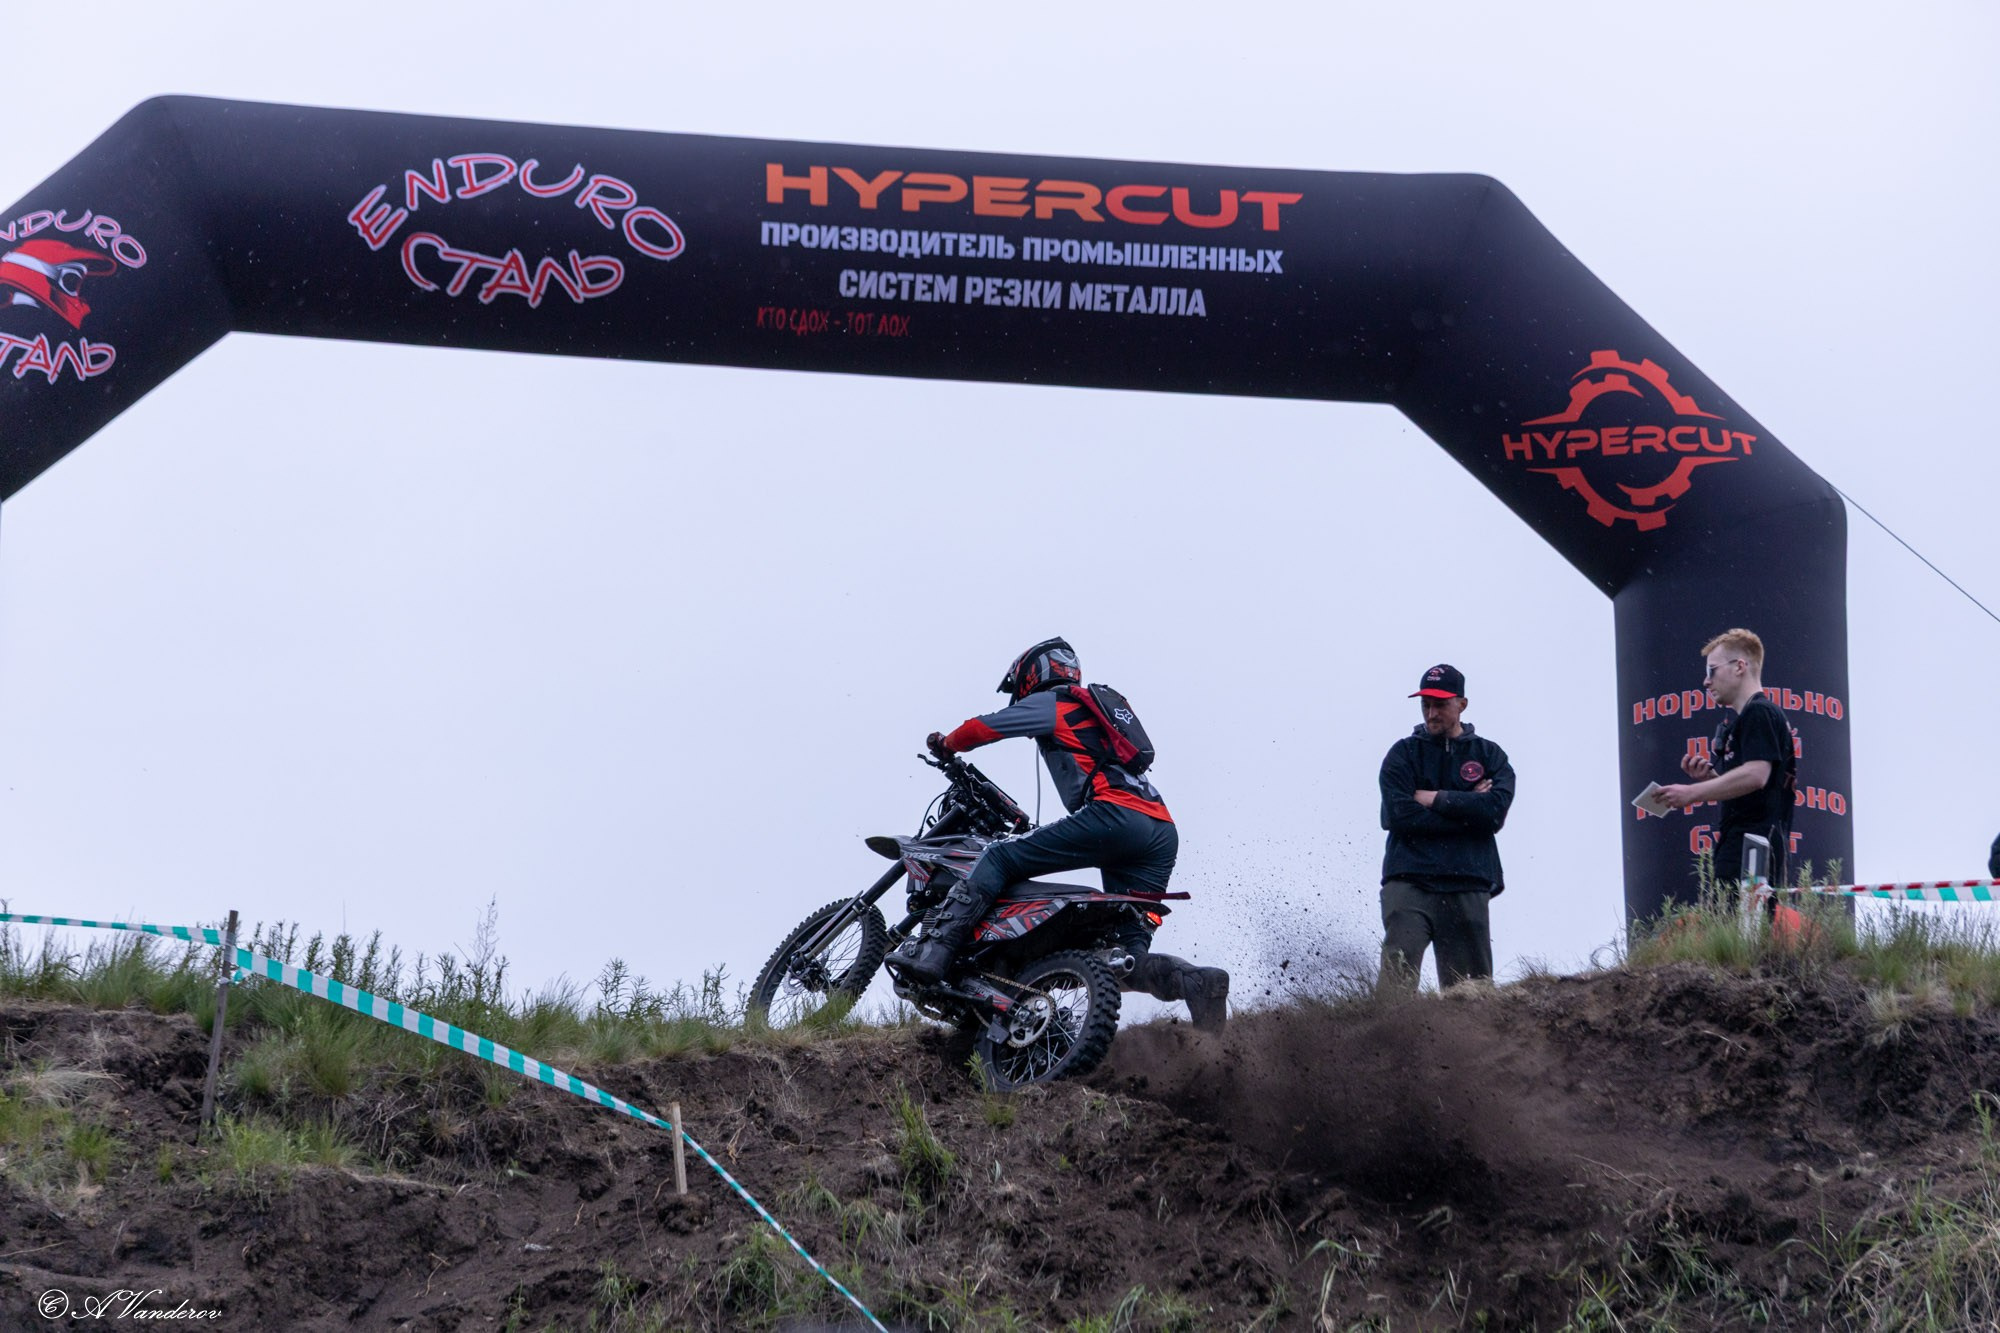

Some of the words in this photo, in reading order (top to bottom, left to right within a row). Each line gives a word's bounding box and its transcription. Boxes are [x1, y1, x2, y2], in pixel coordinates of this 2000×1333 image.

[348, 153, 685, 260] ENDURO
[766, 163, 1303, 231] HYPERCUT
[0, 209, 147, 268] NDURO
[761, 221, 1015, 259] ПРОИЗВОДИТЕЛЬ
[1023, 236, 1283, 274] ПРОМЫШЛЕННЫХ
[839, 269, 957, 303] СИСТЕМ
[964, 276, 1062, 309] РЕЗКИ
[1069, 281, 1206, 317] МЕТАЛЛА
[756, 306, 787, 330] КТО
[789, 308, 829, 336] СДОХ
[847, 311, 875, 335] ТОТ
[877, 314, 910, 337] ЛОХ
[0, 332, 116, 385] TAND
[1502, 425, 1757, 460] HYPERCUT
